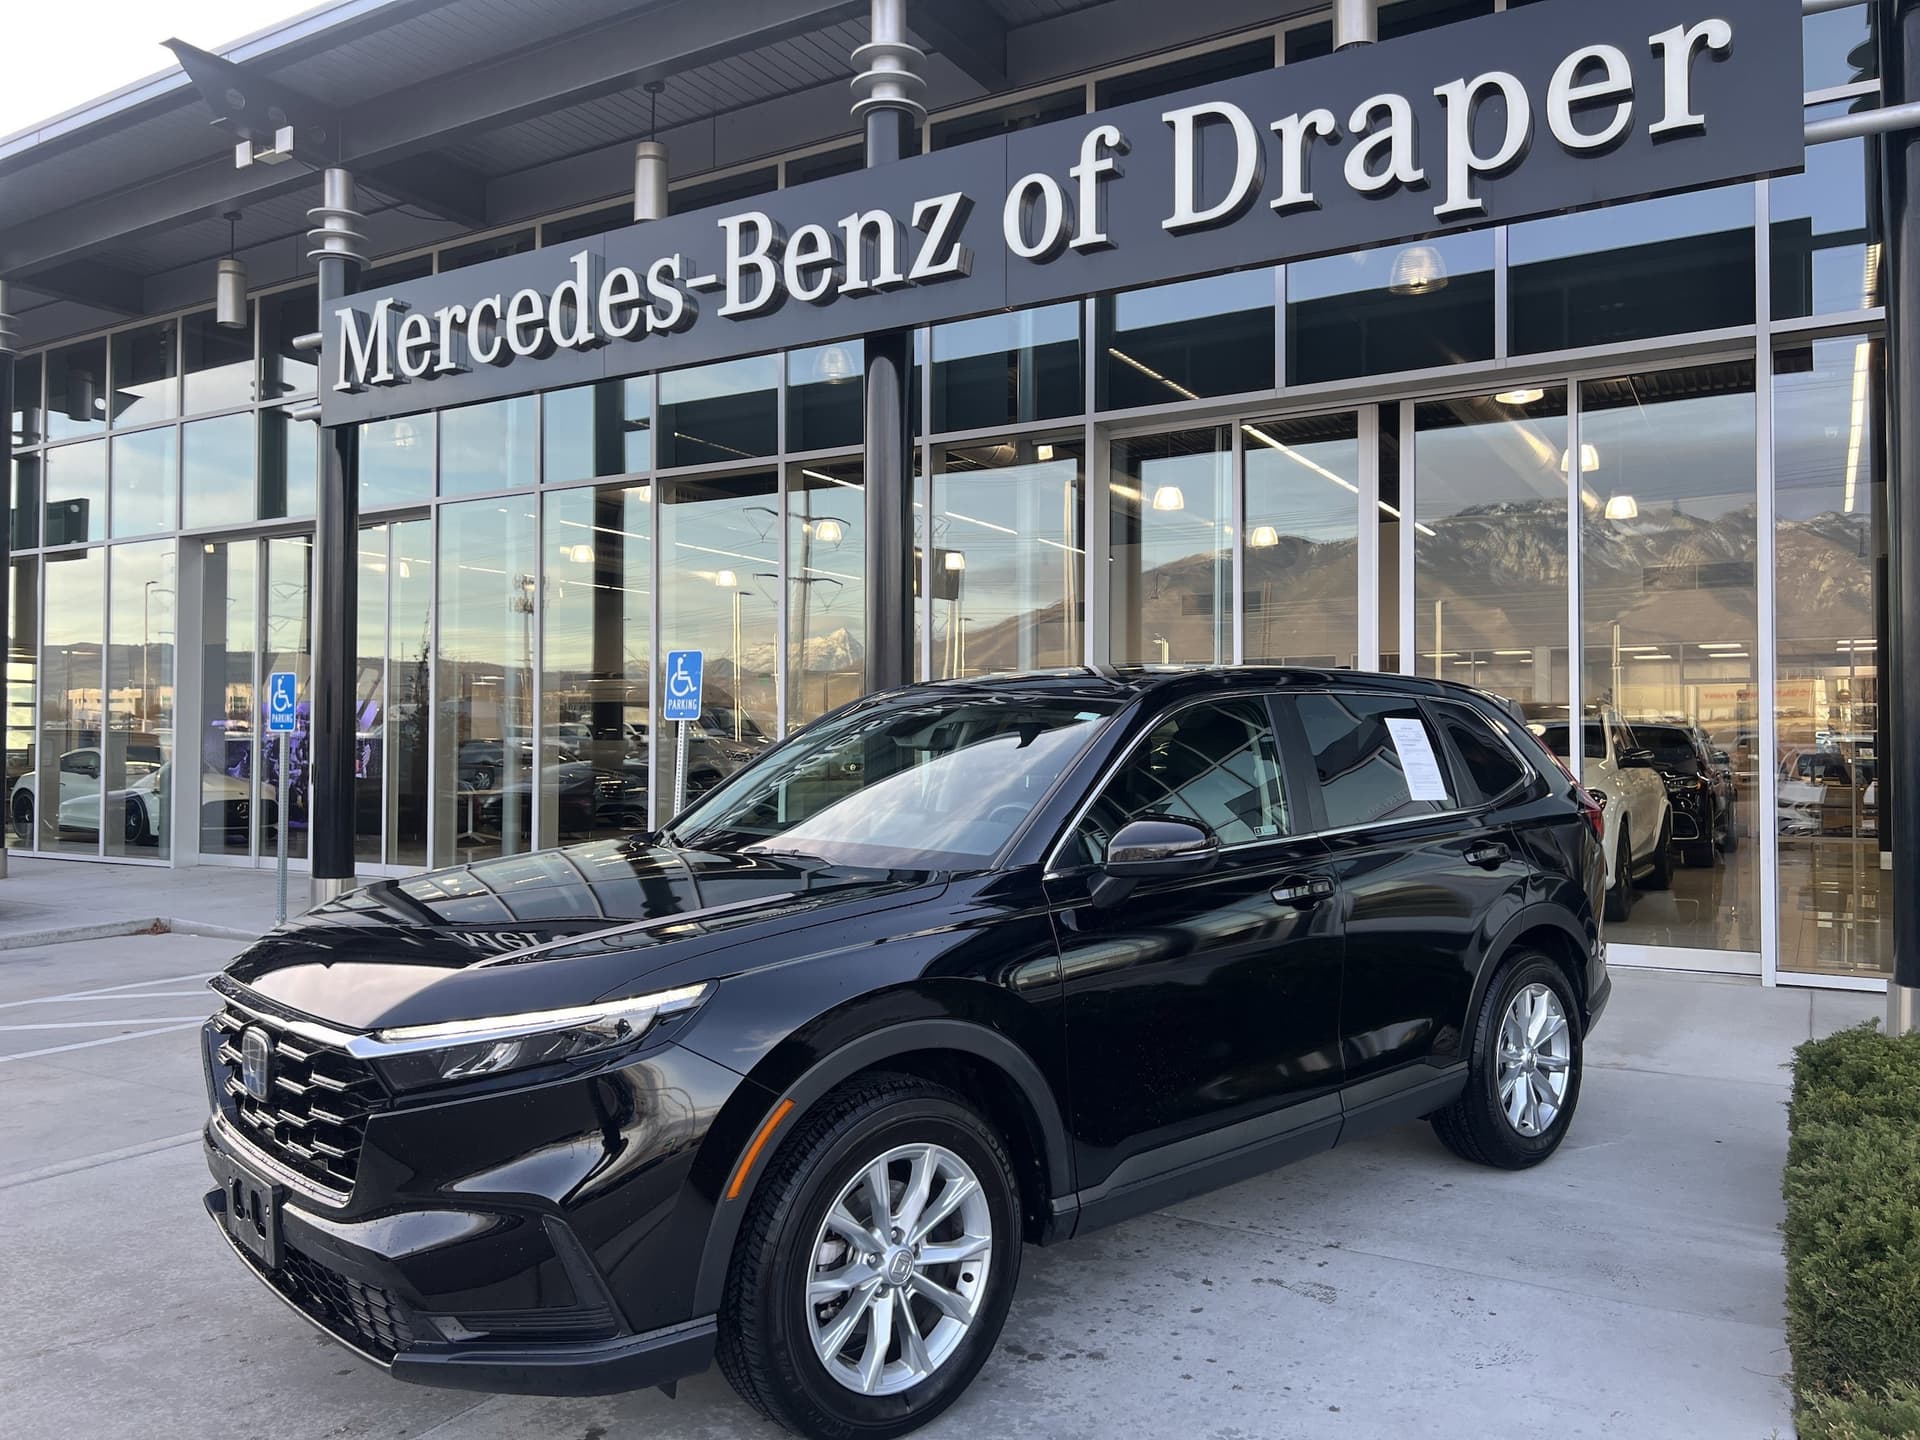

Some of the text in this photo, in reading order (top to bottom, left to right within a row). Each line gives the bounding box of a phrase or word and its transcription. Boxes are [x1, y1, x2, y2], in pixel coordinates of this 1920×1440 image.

[333, 17, 1732, 391] Mercedes-Benz of Draper
[668, 699, 697, 710] PARKING
[272, 713, 293, 723] PARKING
